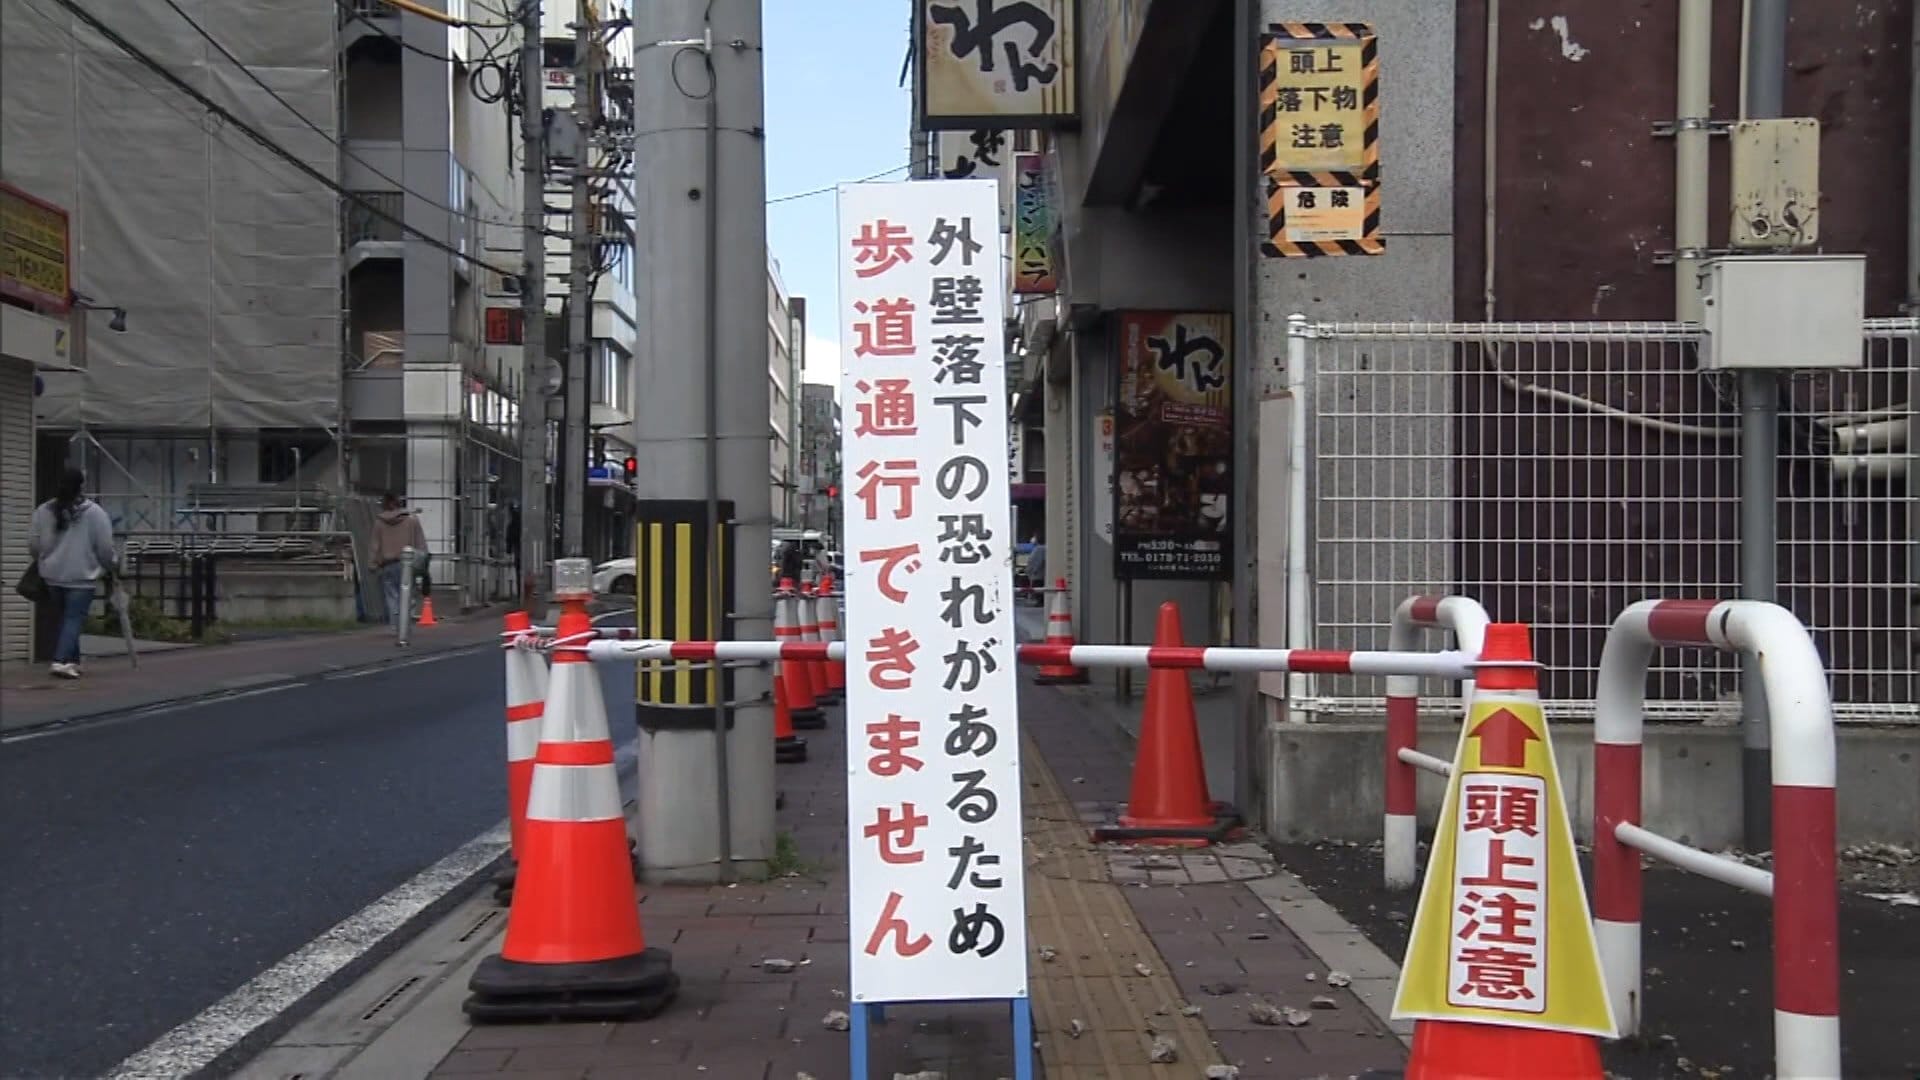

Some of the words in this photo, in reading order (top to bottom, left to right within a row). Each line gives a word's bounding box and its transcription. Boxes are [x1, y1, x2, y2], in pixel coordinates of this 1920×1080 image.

[930, 0, 1058, 92] わん
[1288, 48, 1343, 74] 頭上
[1277, 85, 1357, 112] 落下物
[1291, 123, 1344, 149] 注意
[1297, 189, 1350, 209] 危険
[1147, 323, 1225, 392] わん
[851, 218, 933, 958] 歩道通行できません
[926, 216, 1004, 958] 外壁落下の恐れがあるため
[1457, 784, 1539, 1001] 頭上注意
